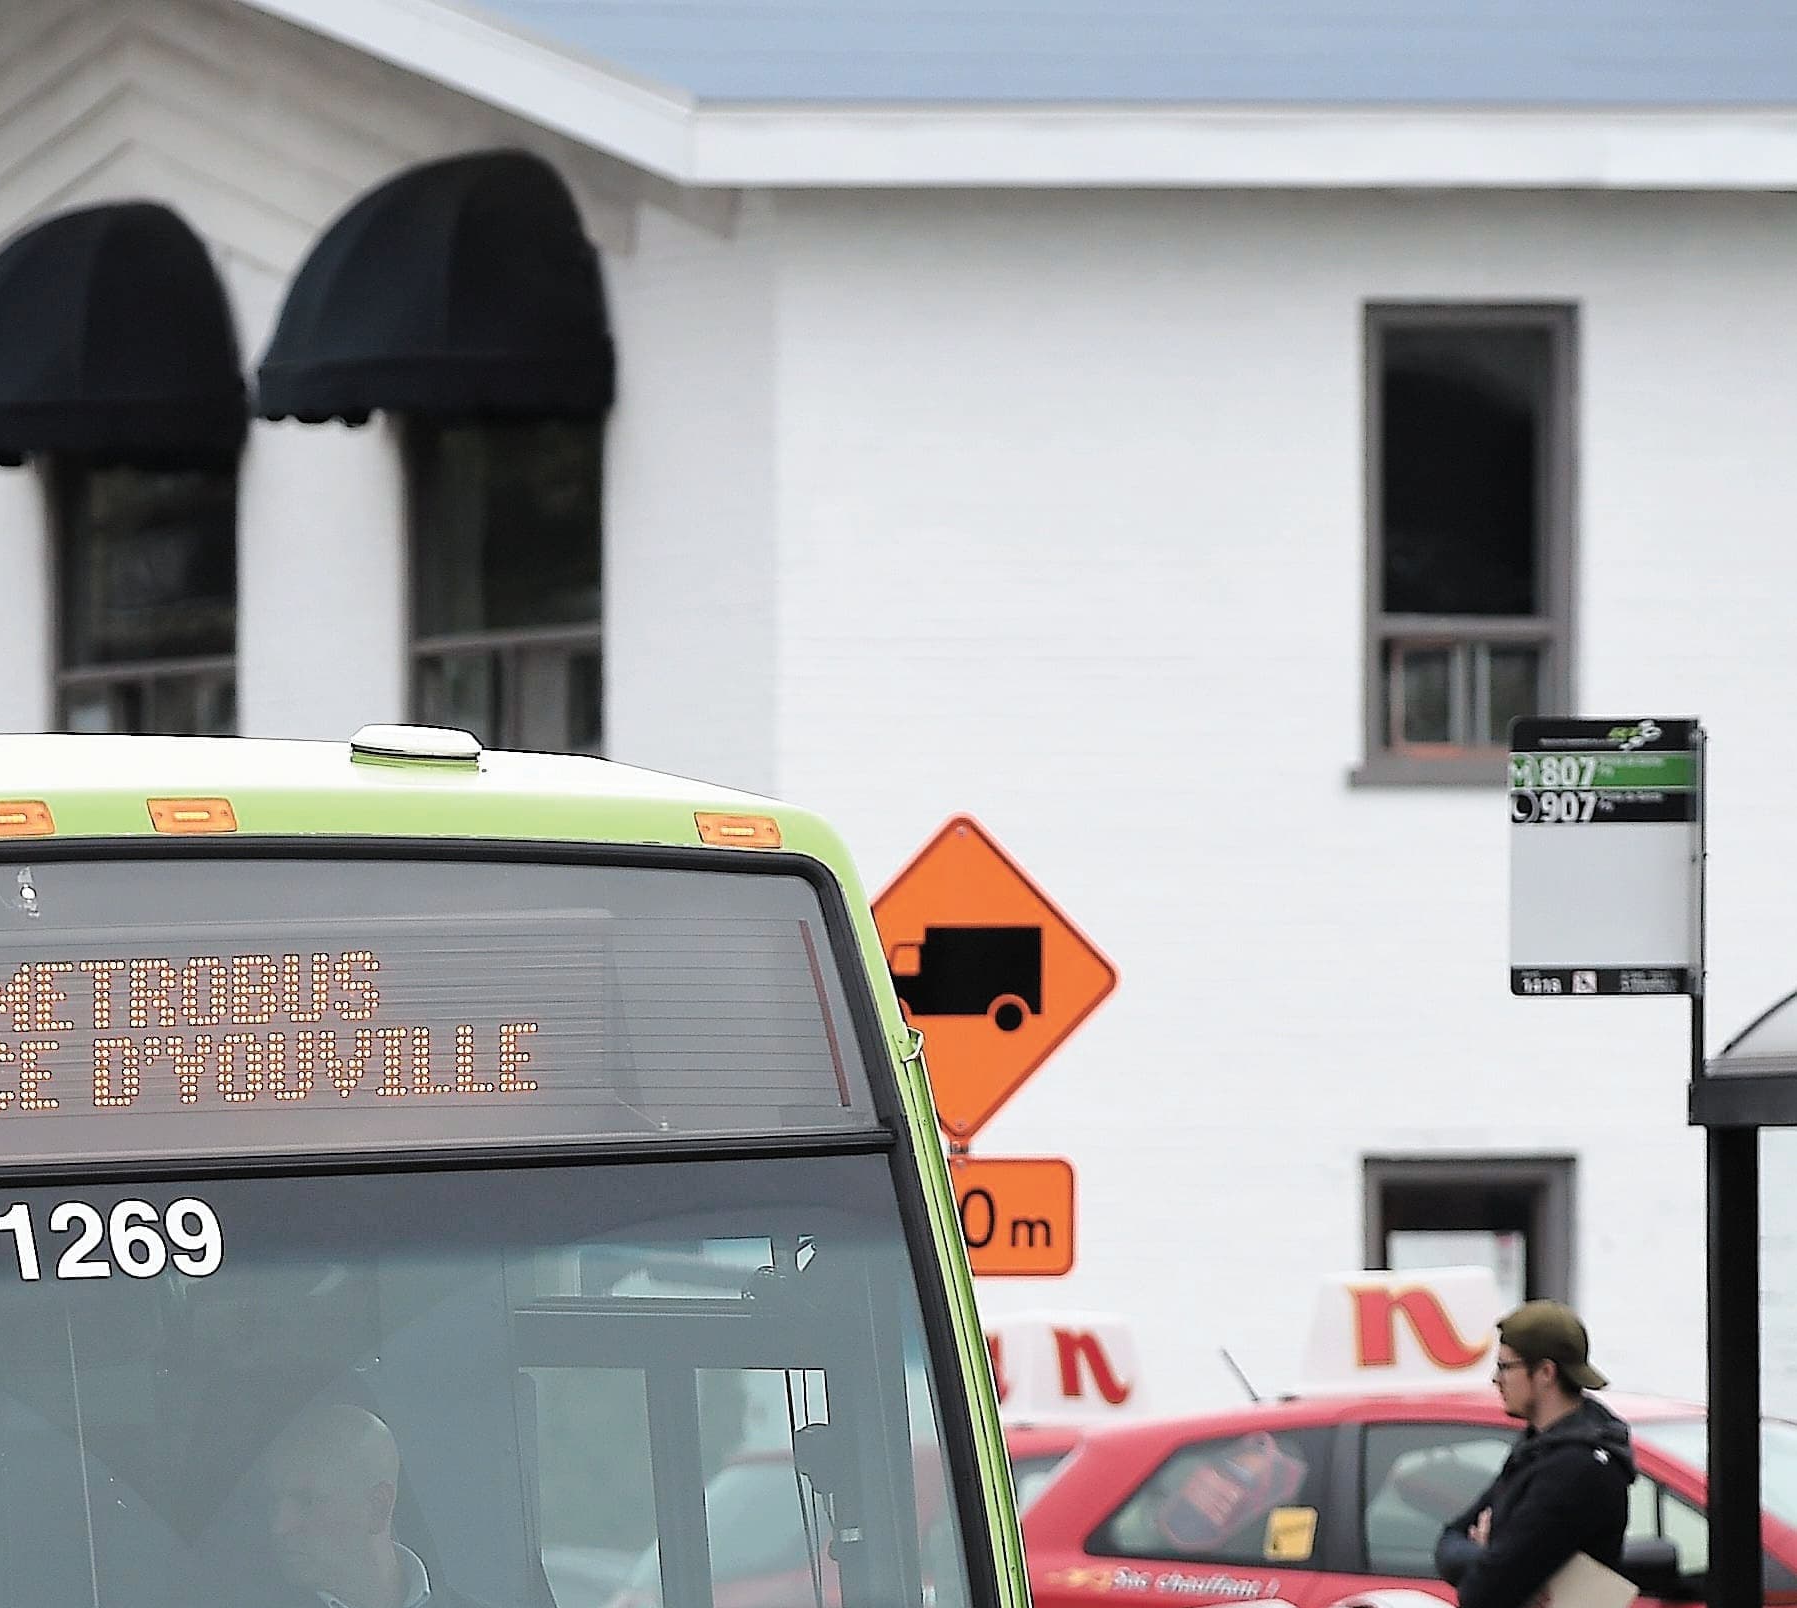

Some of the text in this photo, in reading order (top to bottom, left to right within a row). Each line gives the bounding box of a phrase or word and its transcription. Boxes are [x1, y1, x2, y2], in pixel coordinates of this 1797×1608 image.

[1539, 755, 1596, 787] 807
[1539, 790, 1598, 822] 907
[92, 1022, 540, 1107] D'YOUVILLE
[1010, 1218, 1052, 1248] m
